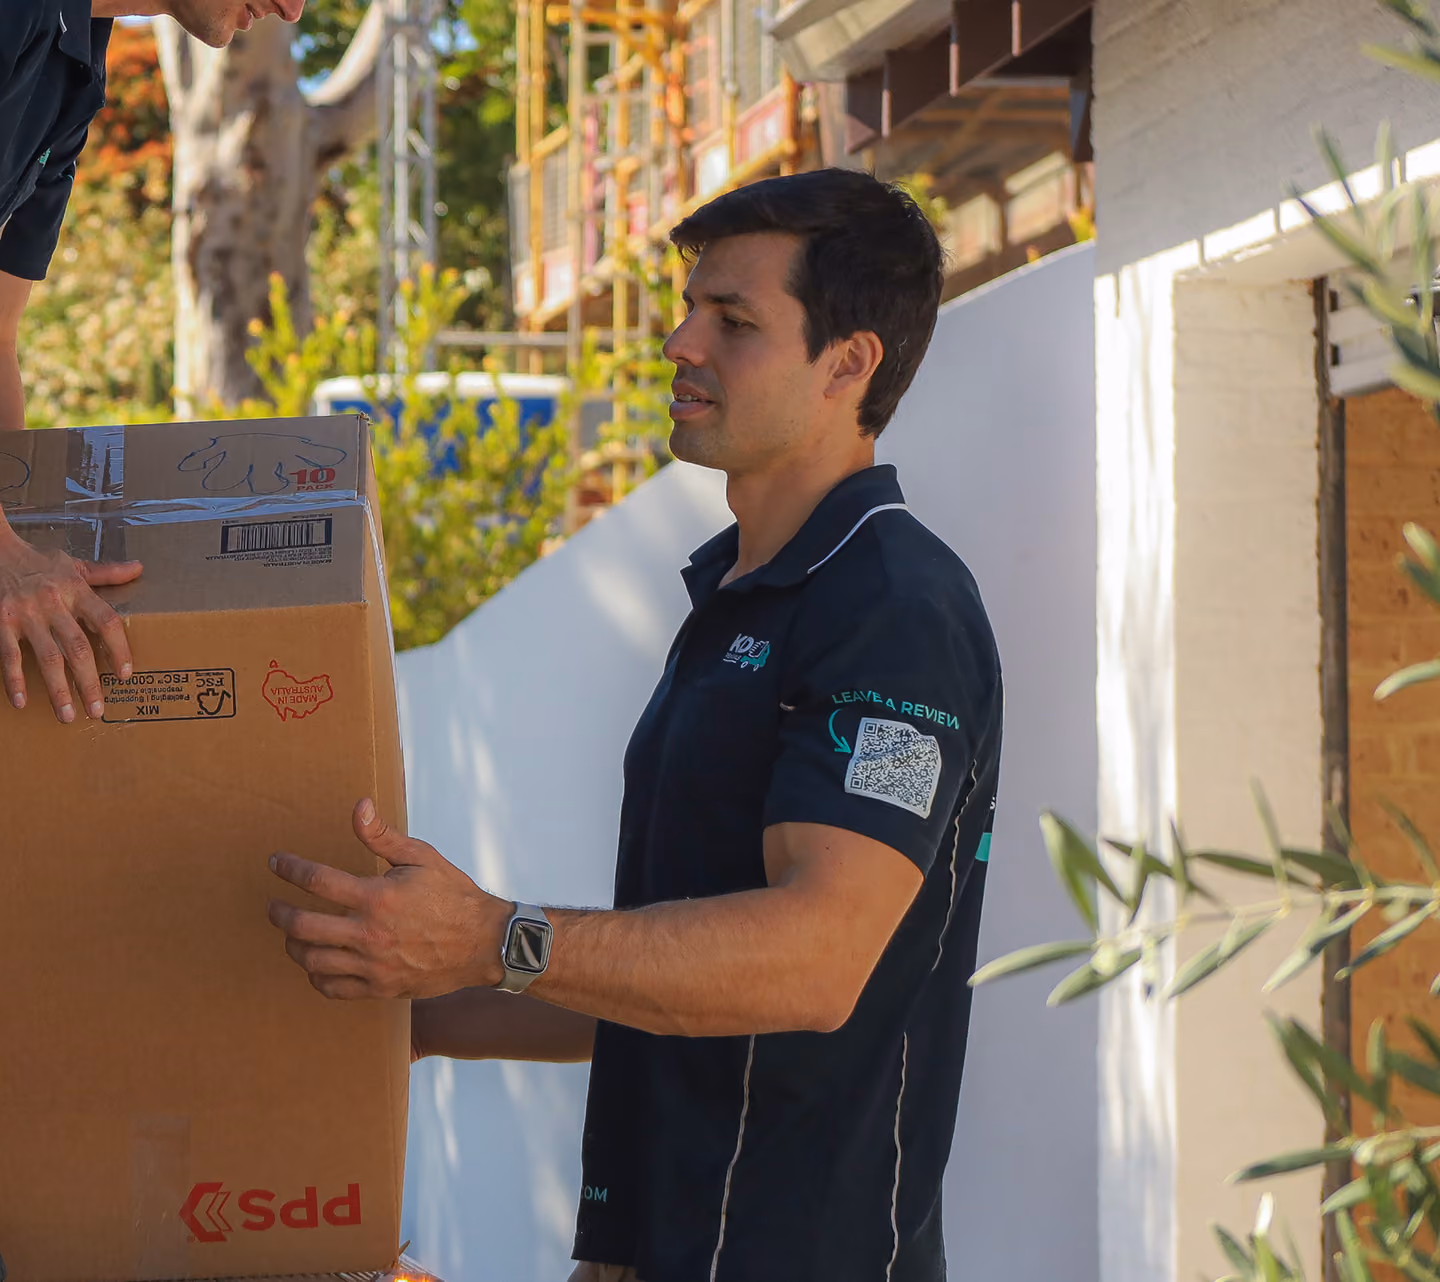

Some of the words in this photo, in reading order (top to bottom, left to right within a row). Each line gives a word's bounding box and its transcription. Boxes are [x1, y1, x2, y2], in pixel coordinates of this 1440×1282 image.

[289, 467, 336, 485] 10
[196, 677, 225, 688] FSC
[110, 687, 139, 696] forestry
[140, 686, 183, 694] responsible
[270, 685, 324, 696] AUSTRALIA
[104, 695, 145, 705] Supporting
[151, 694, 191, 703] Packaging
[278, 696, 288, 704] IN
[290, 694, 318, 704] MADE
[136, 705, 160, 715] MIX
[831, 690, 883, 704] LEAVE
[885, 698, 897, 711] A
[900, 701, 960, 730] REVIEW
[238, 1183, 361, 1231] PPS
